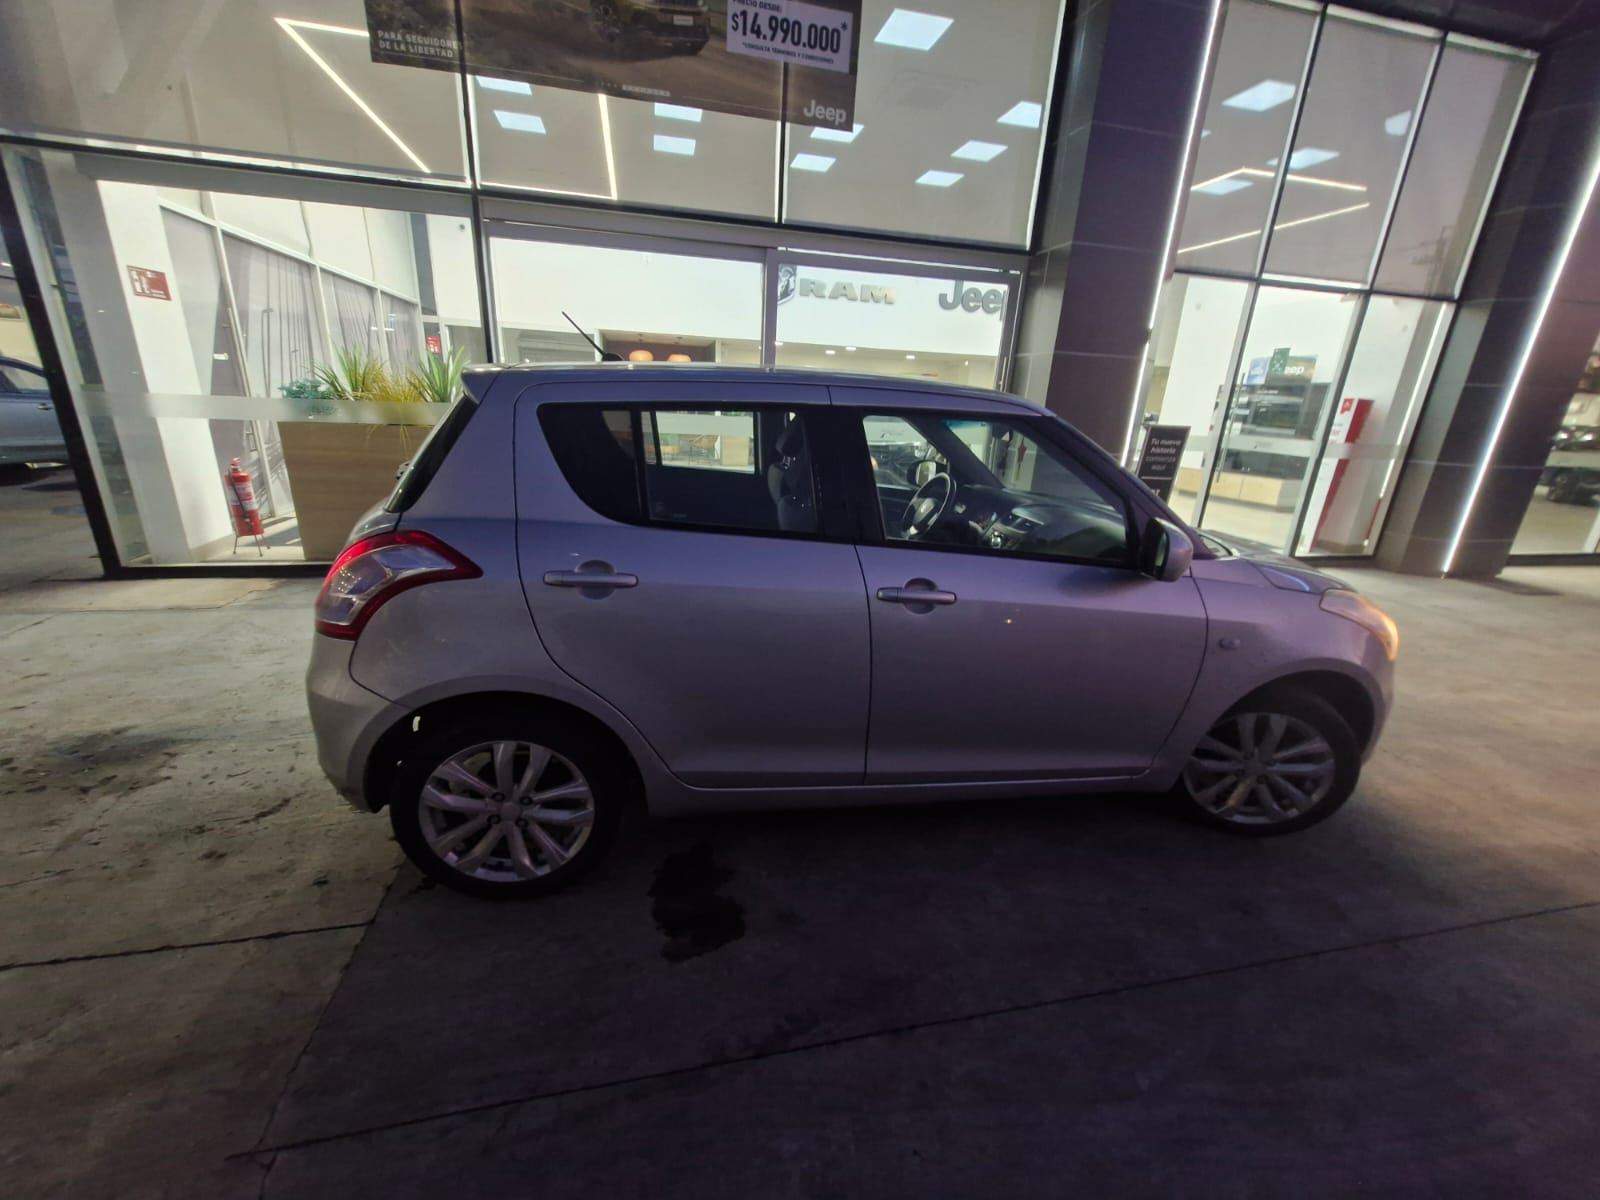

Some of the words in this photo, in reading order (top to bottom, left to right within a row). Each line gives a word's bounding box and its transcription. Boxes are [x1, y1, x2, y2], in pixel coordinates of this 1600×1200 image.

[377, 30, 402, 41] PARA
[409, 45, 454, 58] LIBERTAD
[803, 100, 847, 125] Jeep
[799, 278, 896, 305] RAM
